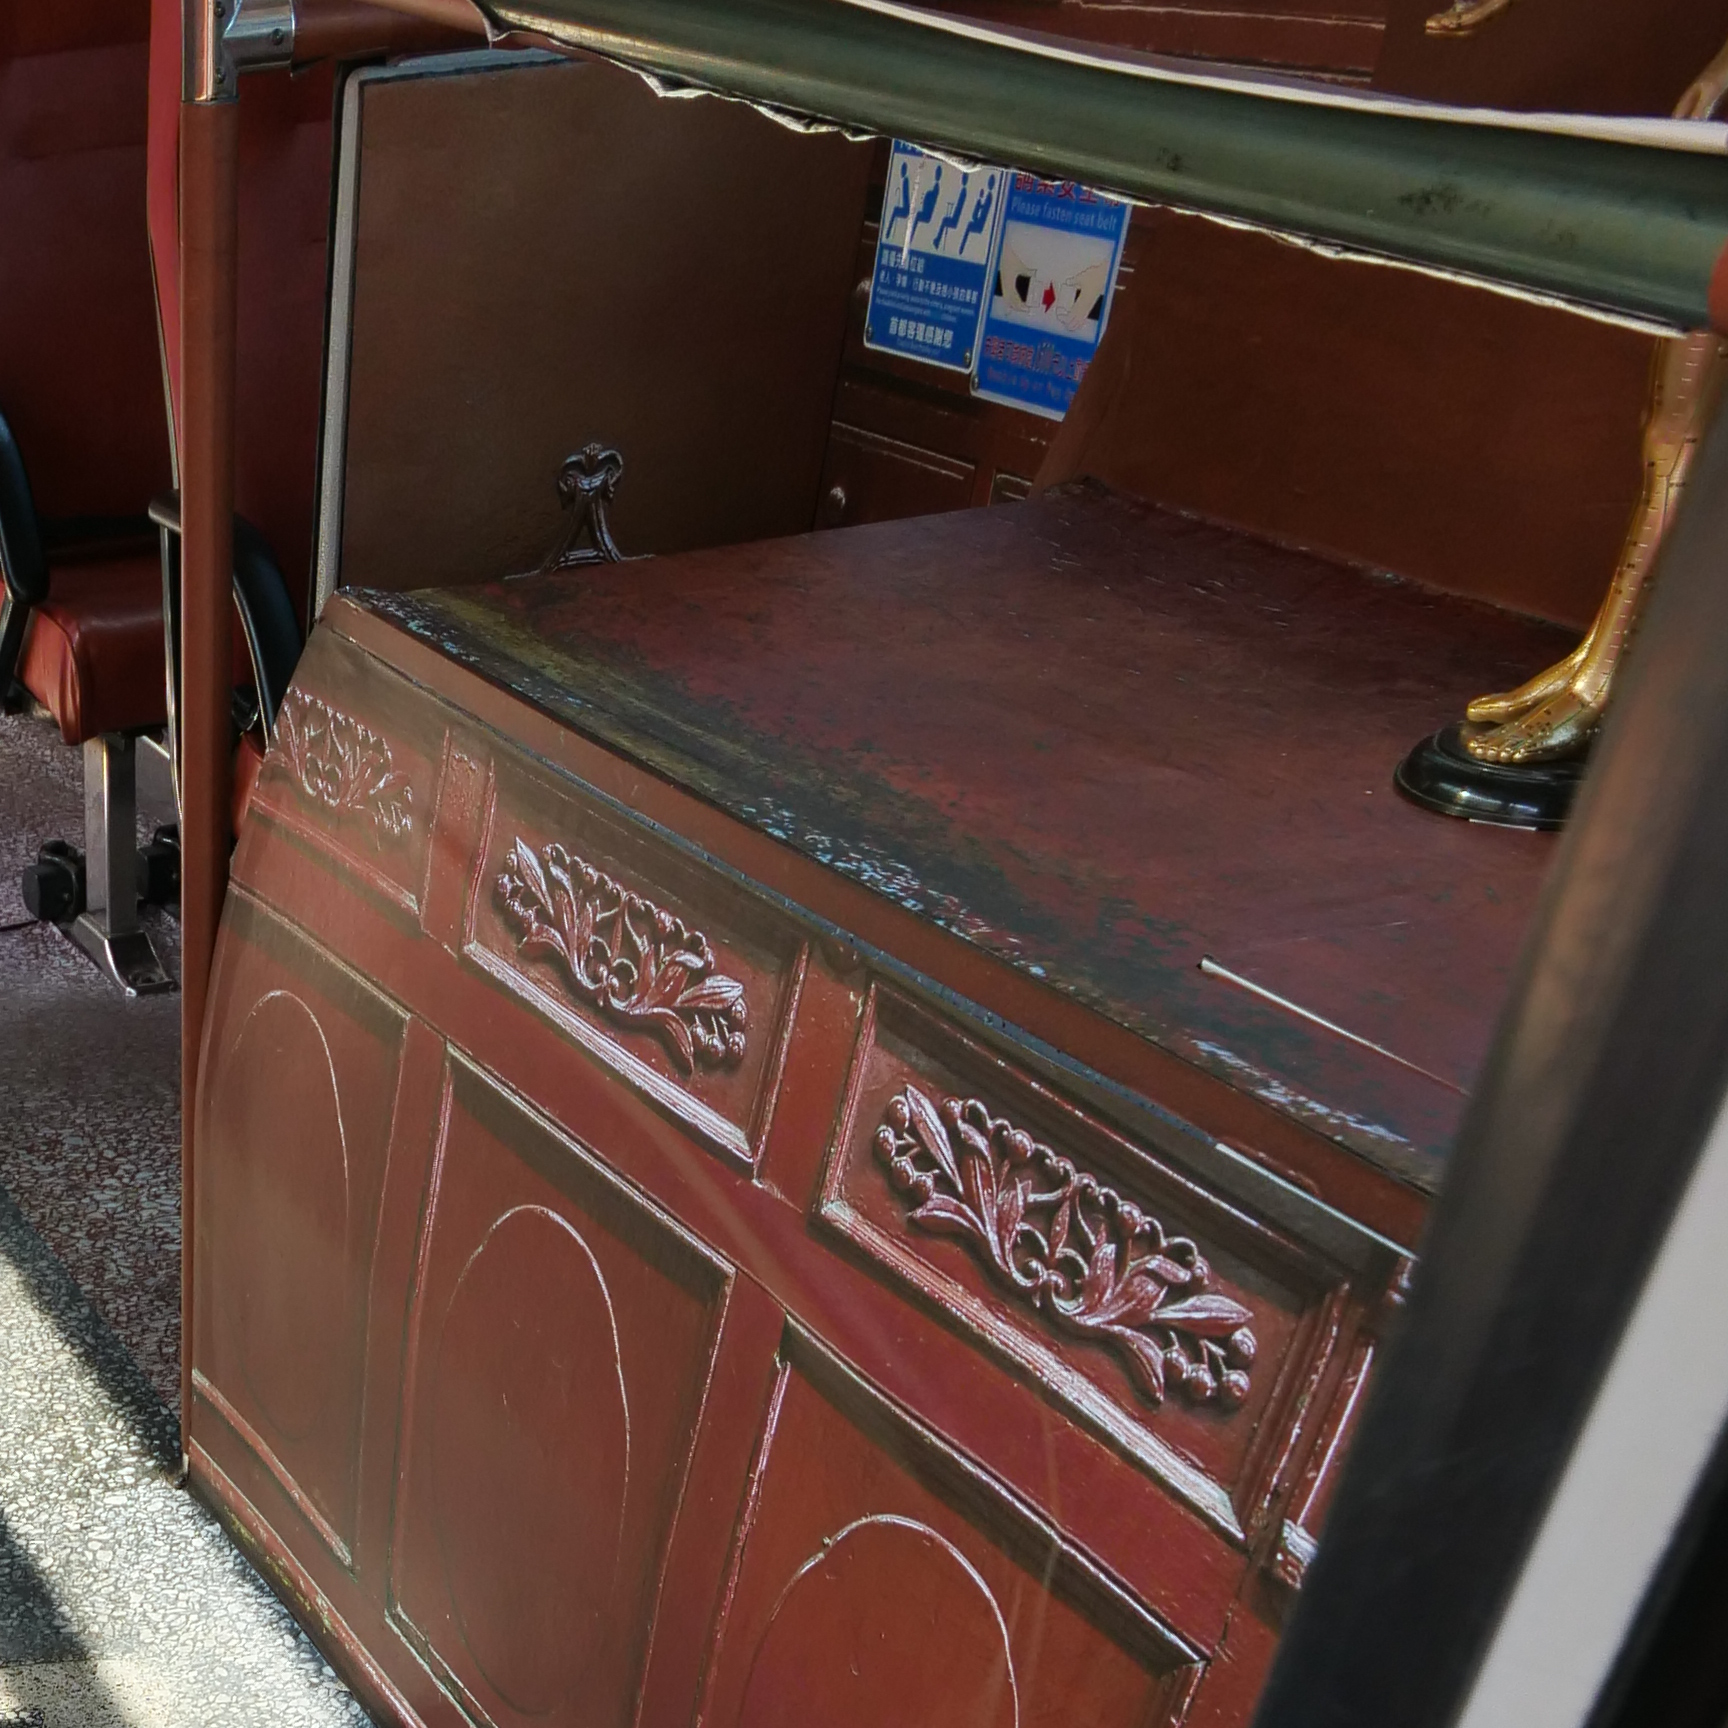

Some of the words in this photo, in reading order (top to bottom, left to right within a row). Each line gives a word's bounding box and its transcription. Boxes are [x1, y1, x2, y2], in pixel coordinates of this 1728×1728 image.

[1012, 197, 1040, 216] Please
[1043, 202, 1072, 222] fasten
[1075, 211, 1094, 226] seat
[1097, 214, 1117, 231] belt
